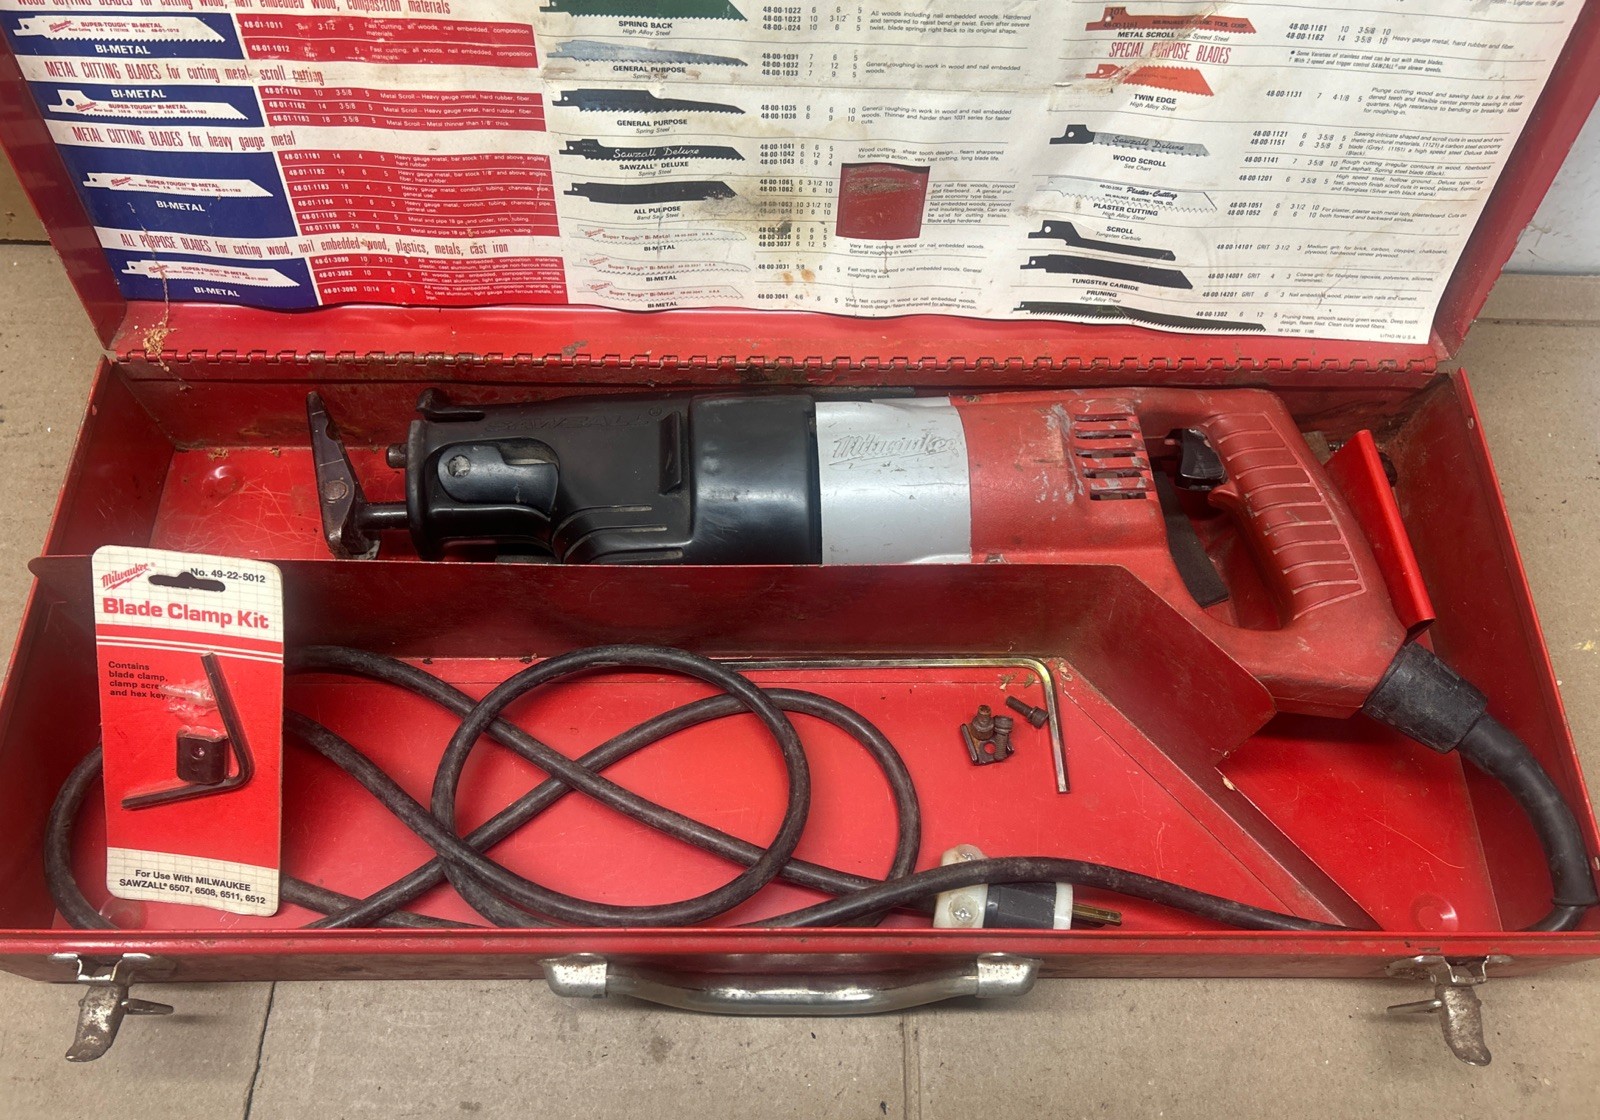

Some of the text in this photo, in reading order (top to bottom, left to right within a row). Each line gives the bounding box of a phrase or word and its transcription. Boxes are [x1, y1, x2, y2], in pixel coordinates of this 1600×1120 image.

[408, 0, 451, 14] materials
[622, 28, 636, 36] High
[638, 29, 654, 37] Alloy
[1192, 34, 1212, 42] Speed
[1392, 35, 1411, 43] Heavy
[95, 44, 151, 55] BI-METAL
[1108, 42, 1232, 64] SPECIAL PURPOSE BLADES
[44, 61, 324, 86] METAL CUTTING BLADES for cutting metal scroll cutting
[650, 66, 686, 74] PURPOSE
[111, 88, 167, 99] BI-METAL
[1134, 94, 1177, 105] TWIN EDGE
[1130, 101, 1177, 112] High Alloy Steel
[654, 118, 688, 127] PURPOSE
[72, 126, 296, 151] METAL CUTTING BLADES for heavy gauge metal
[613, 147, 657, 159] Sawzall
[661, 161, 689, 169] DELUXE
[1112, 154, 1167, 167] WOOD SCROLL
[1136, 164, 1152, 172] Chart
[156, 200, 206, 212] BI-METAL
[1094, 203, 1159, 217] PLASTER CUTTING
[1106, 226, 1134, 235] SCROLL
[120, 233, 509, 259] ALL PURPOSE BLADES for cutting wood, nail embedded wood, plastics, metals, cast iron
[644, 244, 676, 252] BI-METAL
[1072, 278, 1140, 292] TUNGSTEN CARBIDE
[194, 286, 240, 298] BI-METAL
[1086, 290, 1118, 298] PRUNING
[648, 301, 679, 309] BI-METAL
[832, 434, 960, 459] Milwaukee
[190, 568, 266, 584] No. 49-22-5012
[102, 597, 270, 630] Blade Clamp Kit
[108, 660, 150, 671] Contains
[108, 670, 169, 683] blade clamp,
[110, 680, 161, 690] clamp scre
[110, 690, 128, 698] and
[130, 690, 148, 698] hex
[136, 869, 251, 892] For Use With MILWAUKEE
[170, 884, 194, 895] 6507,
[195, 887, 219, 898] 6508,
[220, 890, 244, 902] 6511,
[245, 894, 266, 905] 6512
